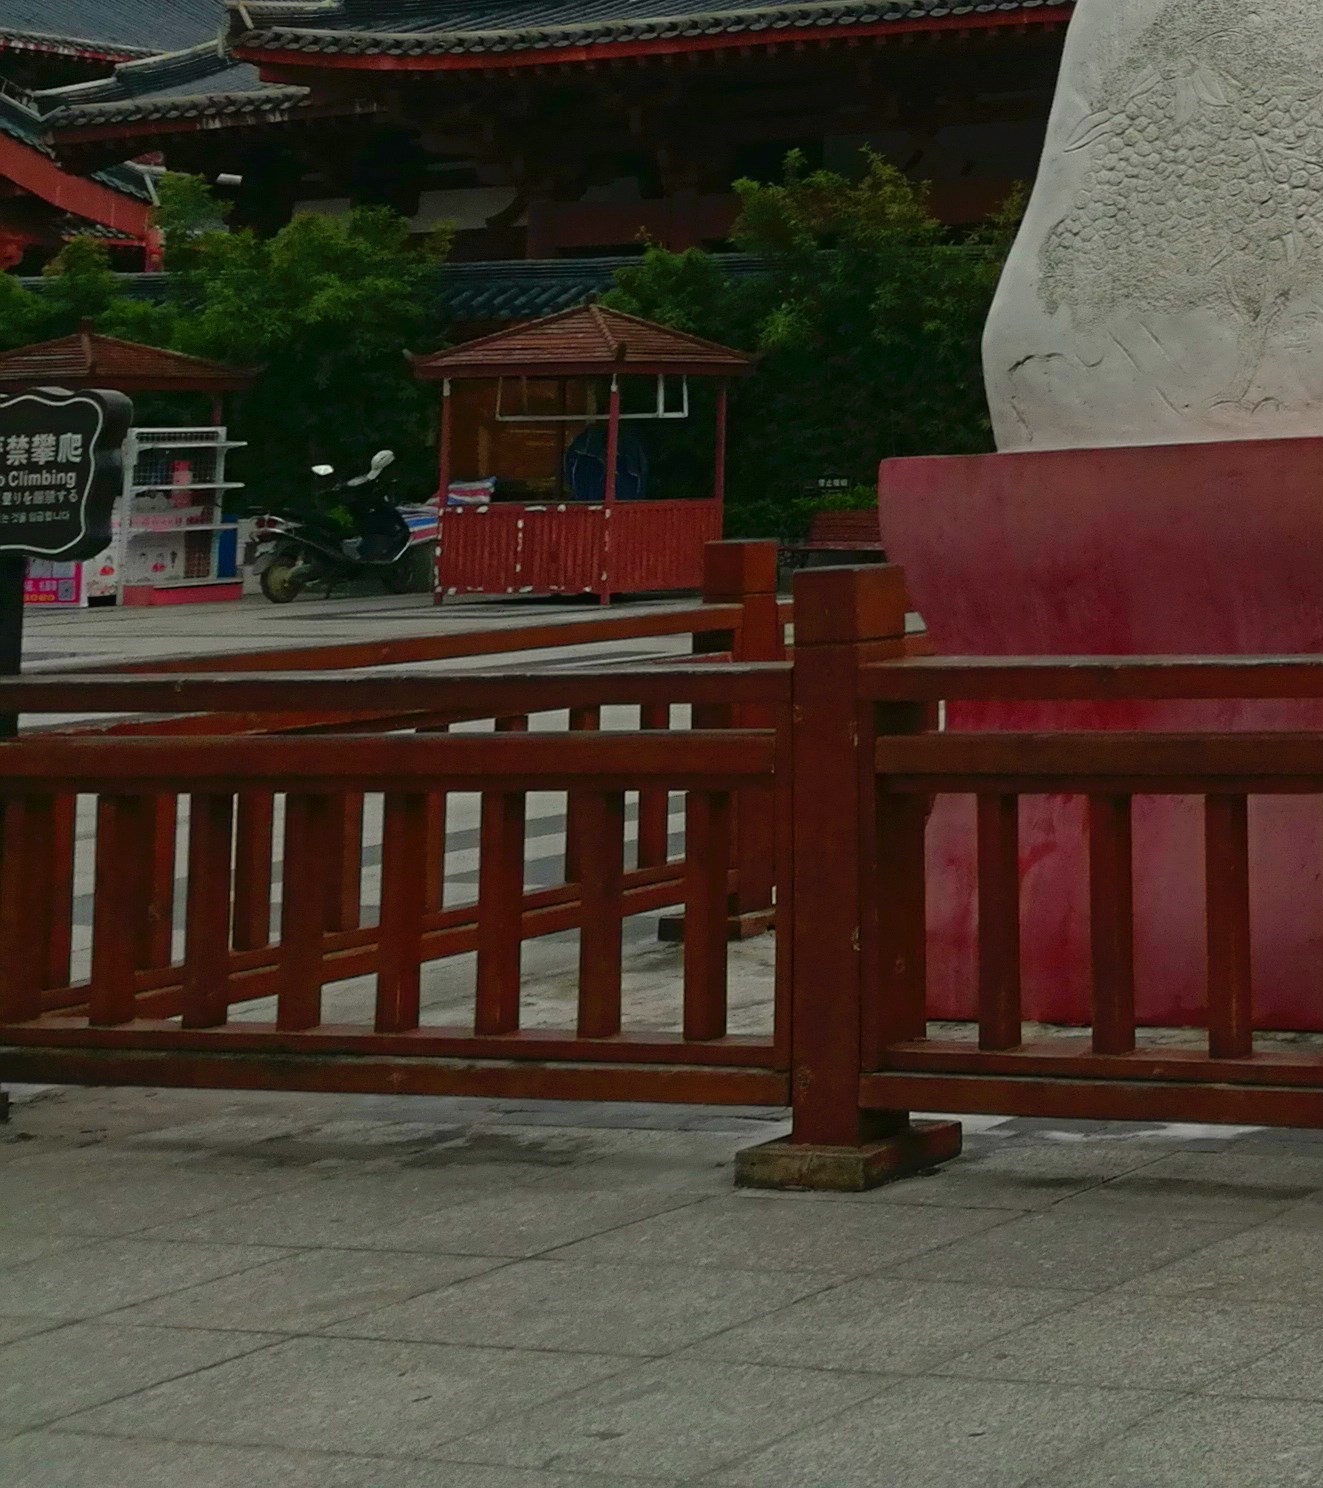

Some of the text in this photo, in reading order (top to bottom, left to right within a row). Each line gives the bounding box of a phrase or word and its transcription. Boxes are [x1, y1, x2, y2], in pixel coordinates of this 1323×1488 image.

[0, 433, 82, 465] 禁攀爬
[8, 470, 76, 488] Climbing
